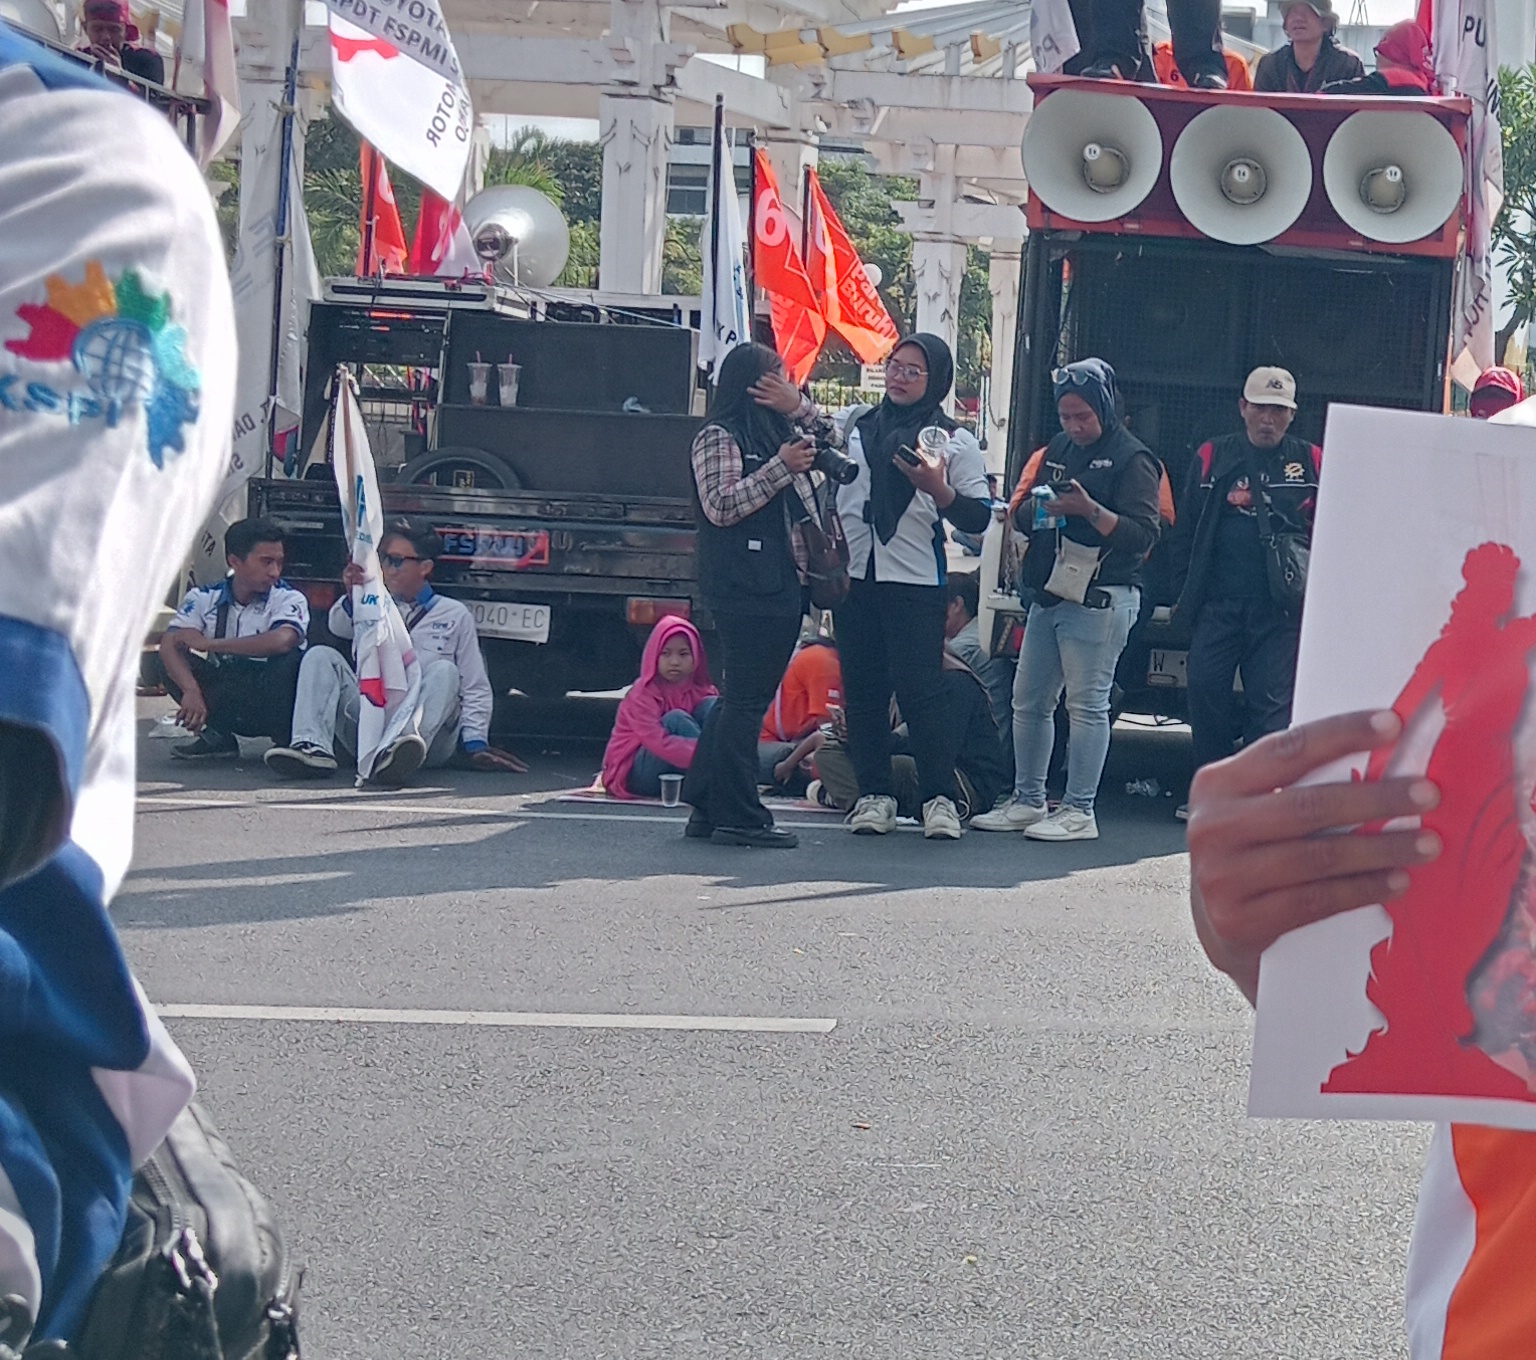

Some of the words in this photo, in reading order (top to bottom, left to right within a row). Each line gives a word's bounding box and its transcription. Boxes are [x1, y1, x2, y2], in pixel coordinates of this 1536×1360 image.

[383, 16, 448, 66] FSPMI
[755, 187, 788, 247] 6
[521, 609, 546, 629] EC
[1152, 651, 1165, 673] W
